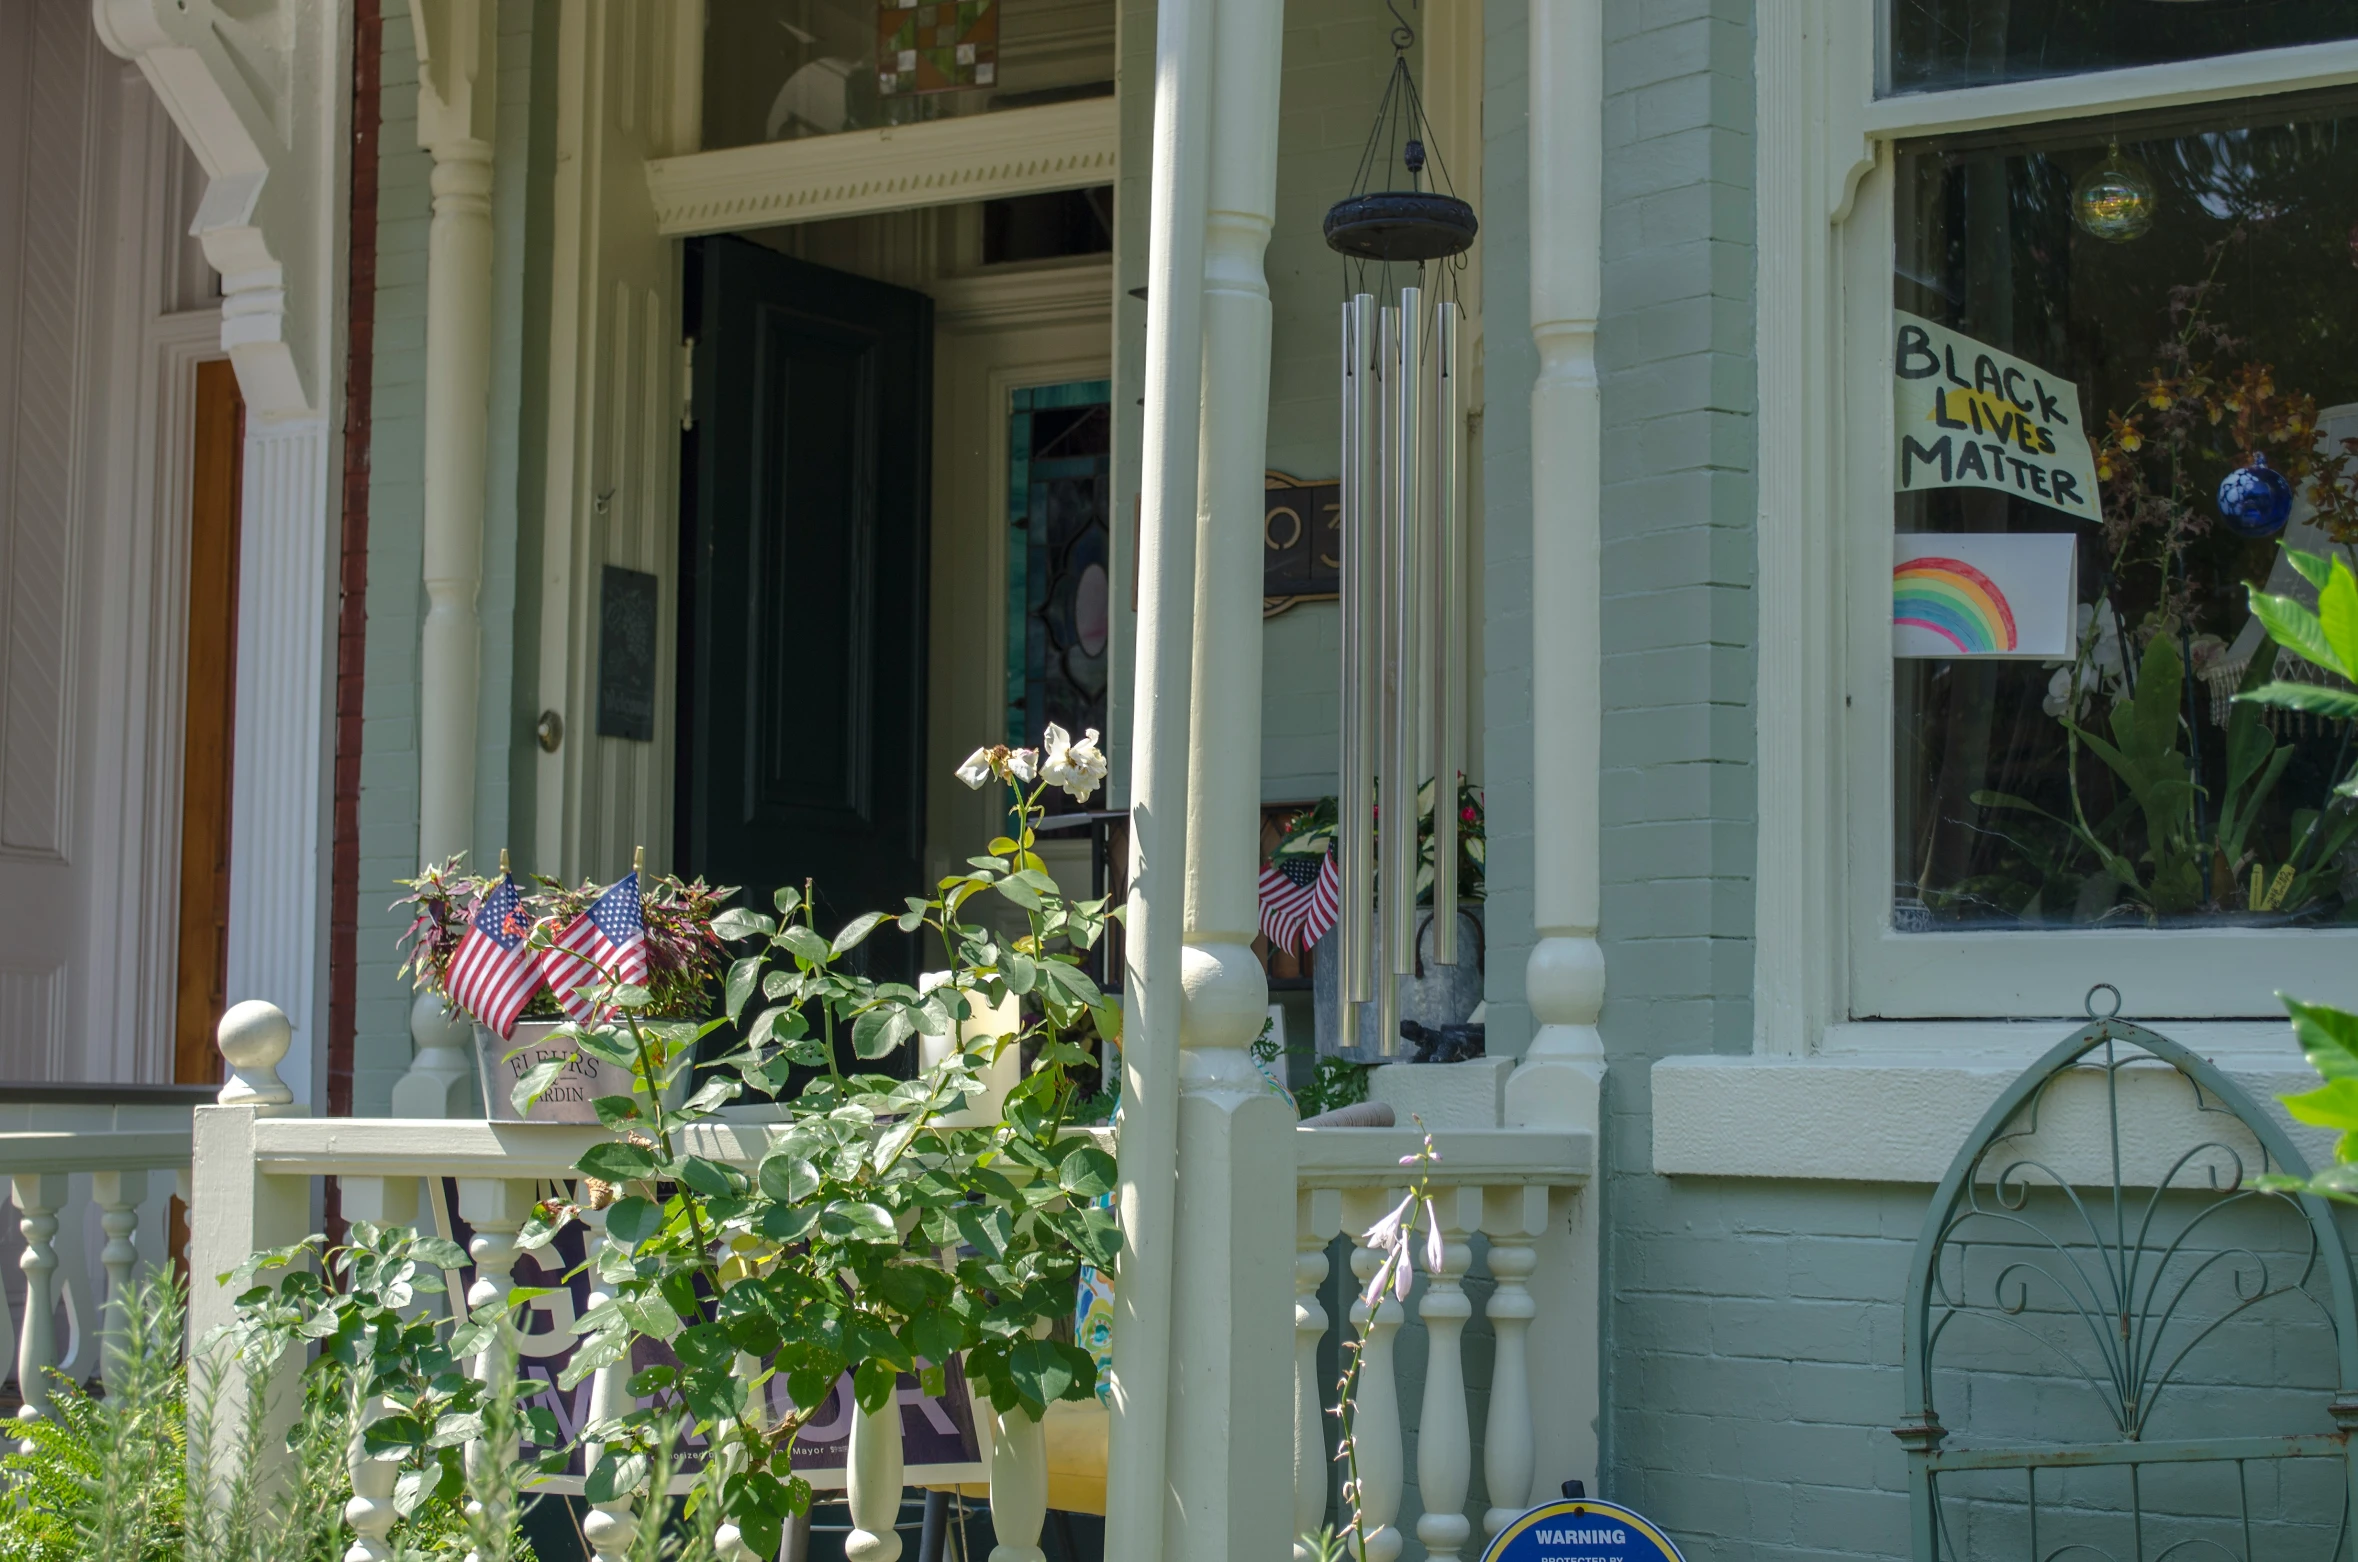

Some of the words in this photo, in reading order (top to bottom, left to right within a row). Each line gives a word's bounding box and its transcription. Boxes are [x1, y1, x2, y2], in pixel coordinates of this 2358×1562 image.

[1895, 325, 2068, 425] BLACK
[1936, 386, 2056, 455] LIVES
[1901, 434, 2084, 505] MATTER
[793, 1447, 824, 1456] Mayor
[1535, 1529, 1626, 1545] WARNING
